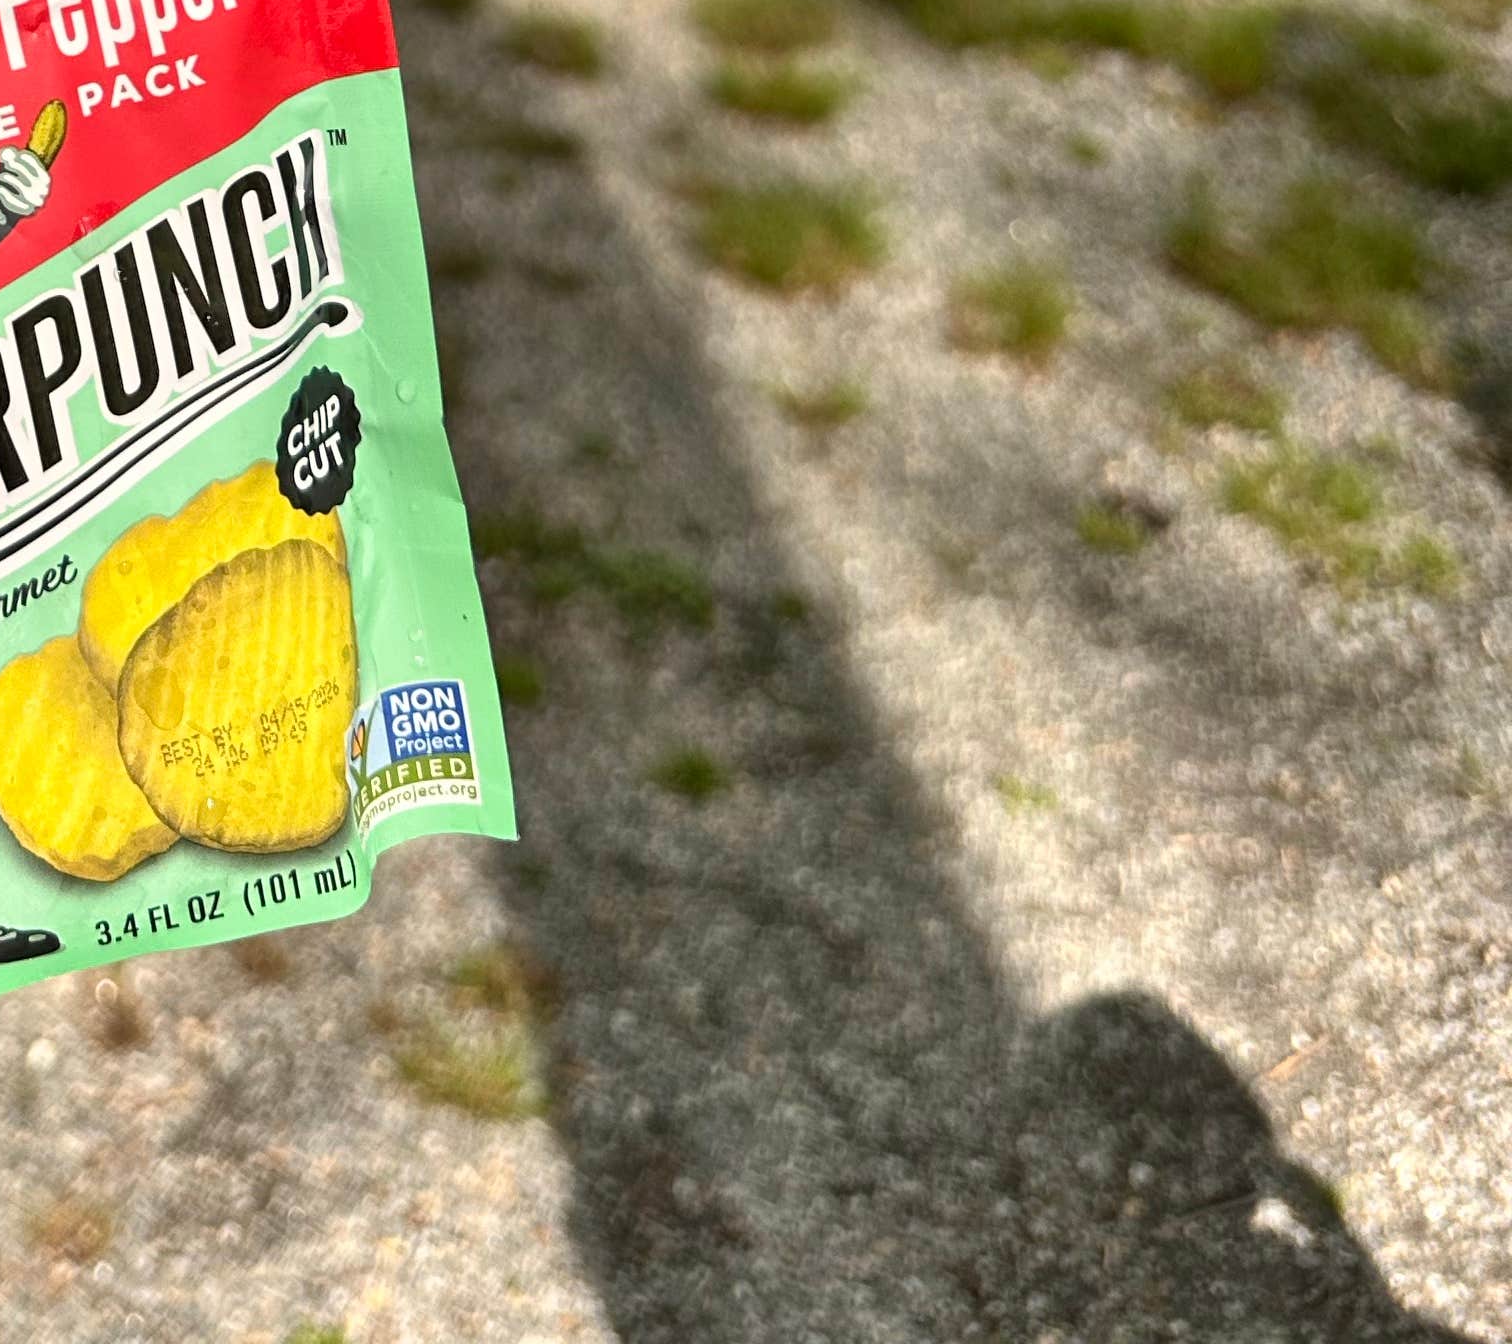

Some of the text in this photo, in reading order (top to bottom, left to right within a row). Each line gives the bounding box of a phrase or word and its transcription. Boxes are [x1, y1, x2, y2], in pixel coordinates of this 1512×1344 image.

[77, 55, 207, 118] PACK
[287, 394, 341, 457] CHIP
[293, 431, 344, 491] CUT
[389, 687, 457, 716] NON
[392, 709, 462, 738] GMO
[160, 733, 203, 769] BEST
[394, 732, 465, 758] Project
[354, 757, 468, 818] VERIFIED
[95, 849, 358, 946] 3.4 FL OZ (101 mL)
